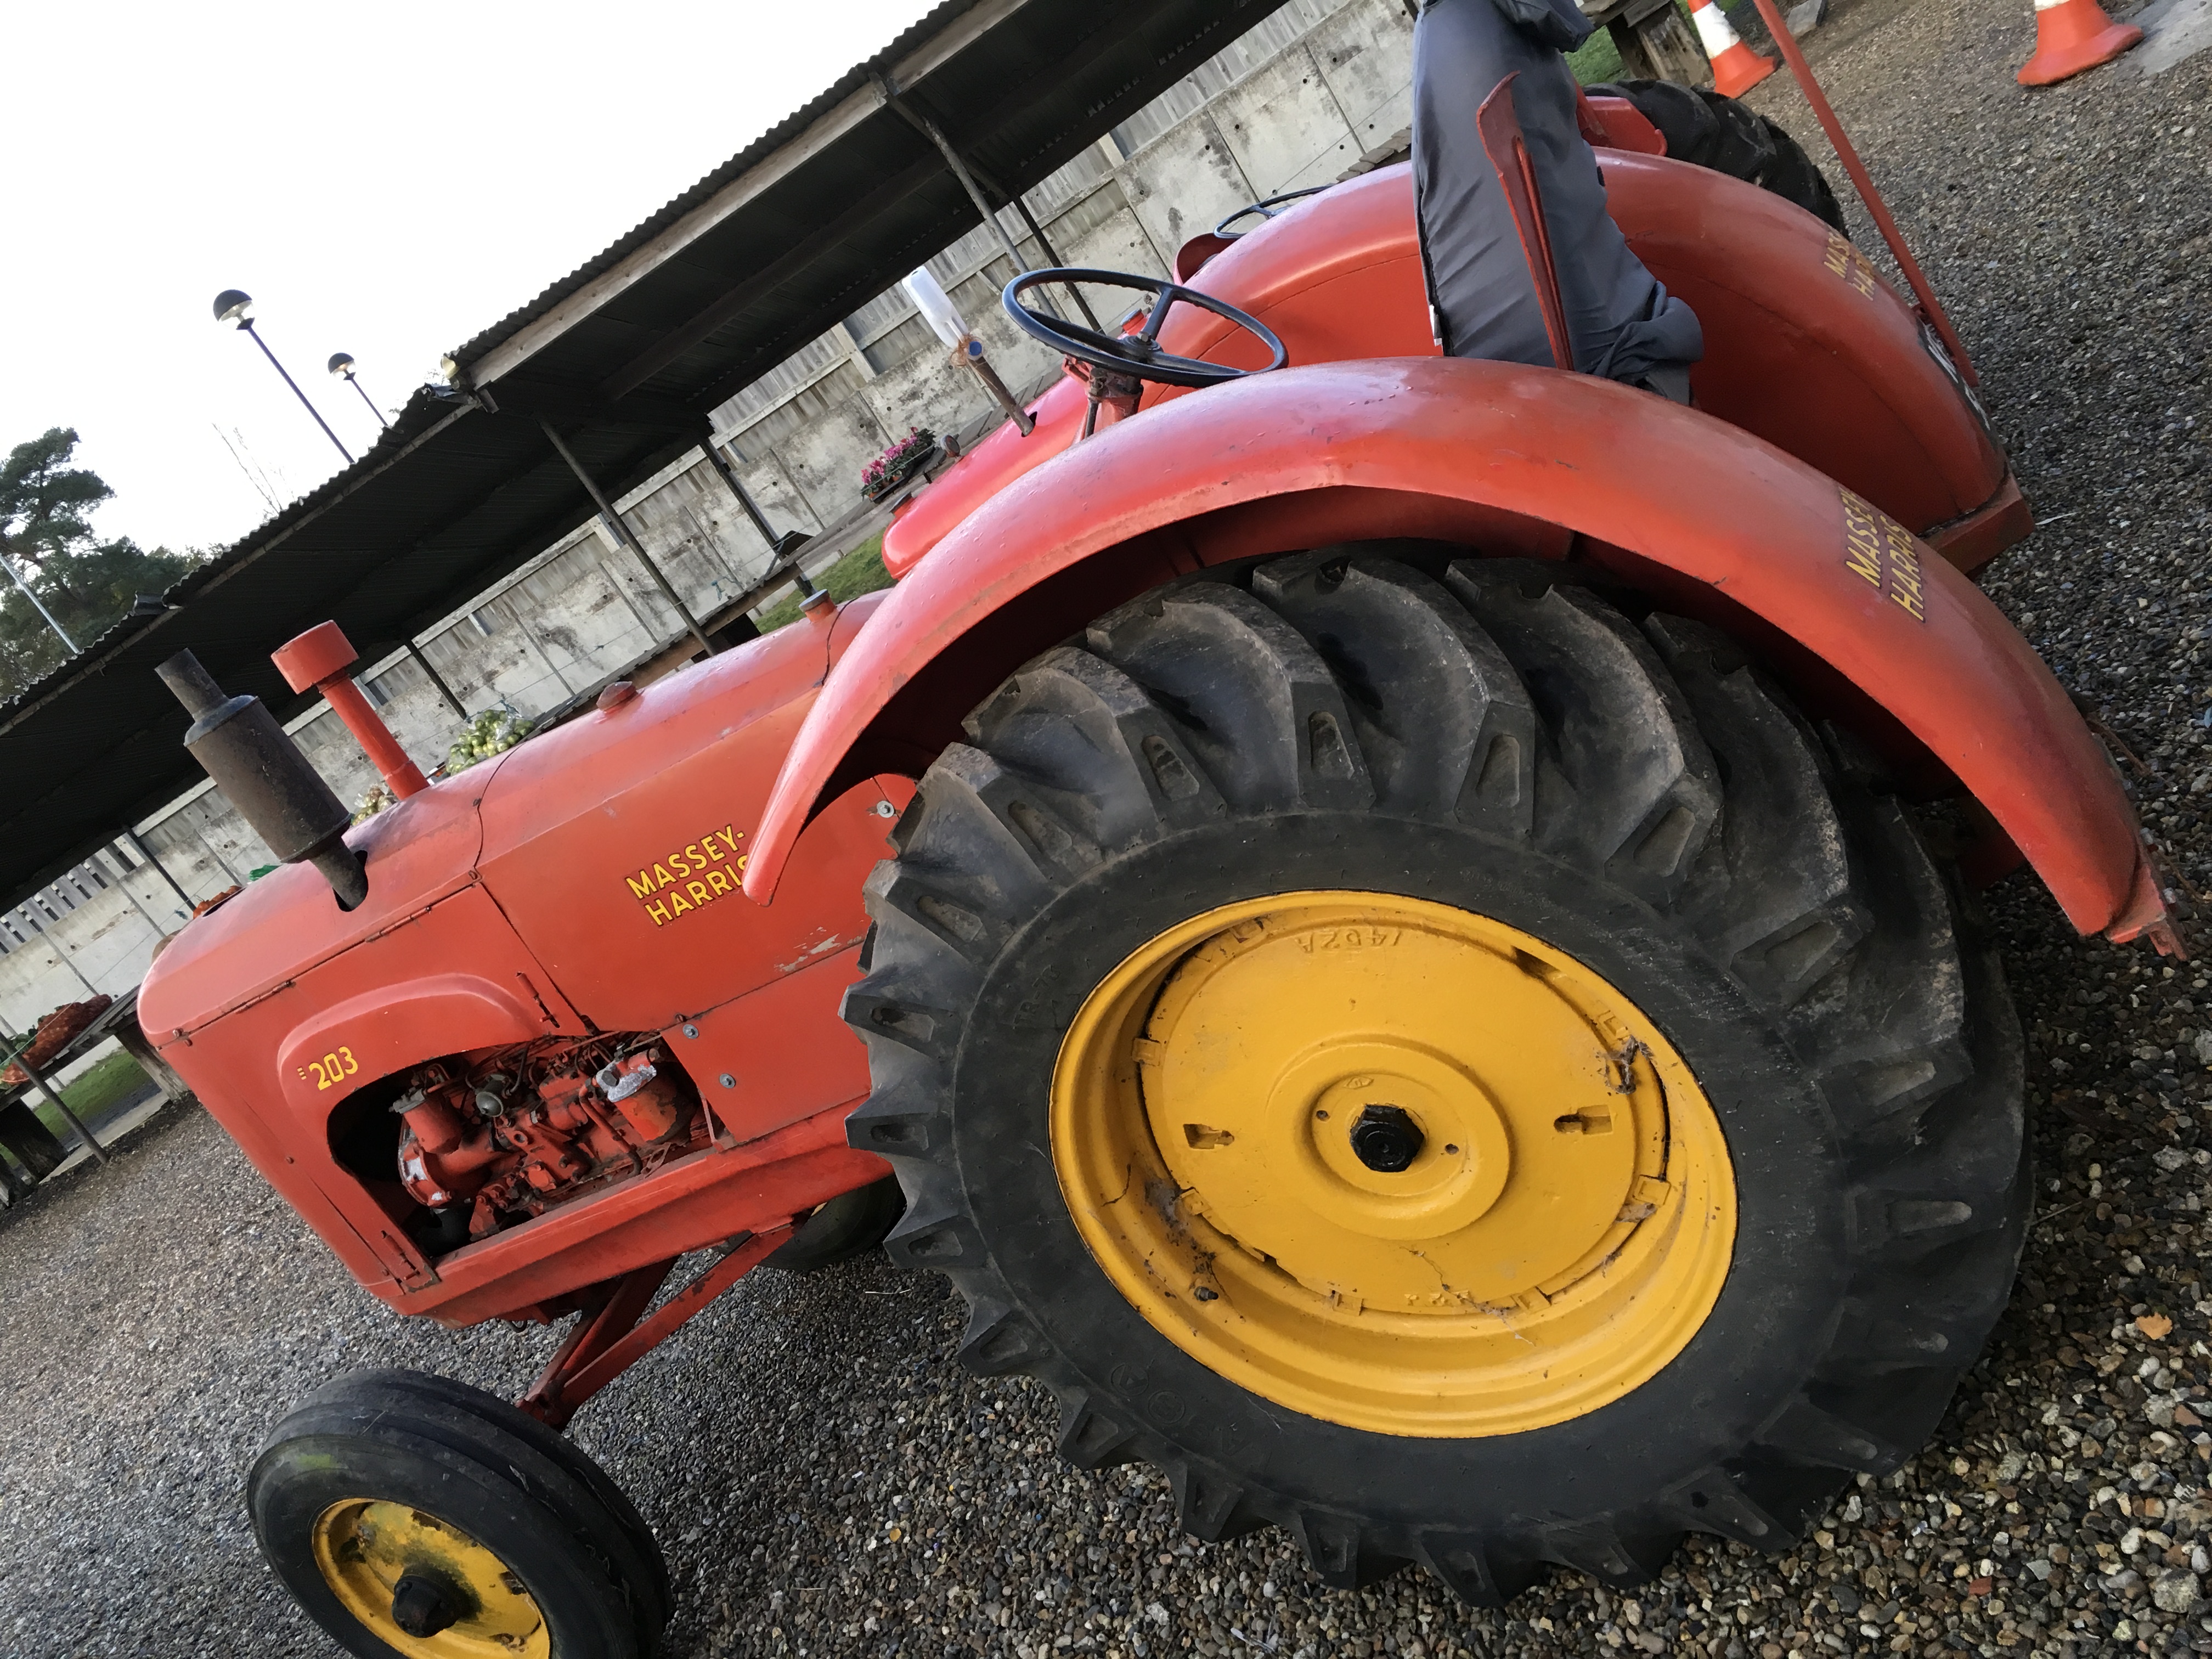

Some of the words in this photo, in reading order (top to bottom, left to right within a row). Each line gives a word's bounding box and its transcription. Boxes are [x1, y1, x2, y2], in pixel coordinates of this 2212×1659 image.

[1880, 515, 1924, 621] HARRIS
[625, 824, 744, 899] MASSEY-
[308, 1046, 358, 1091] 203
